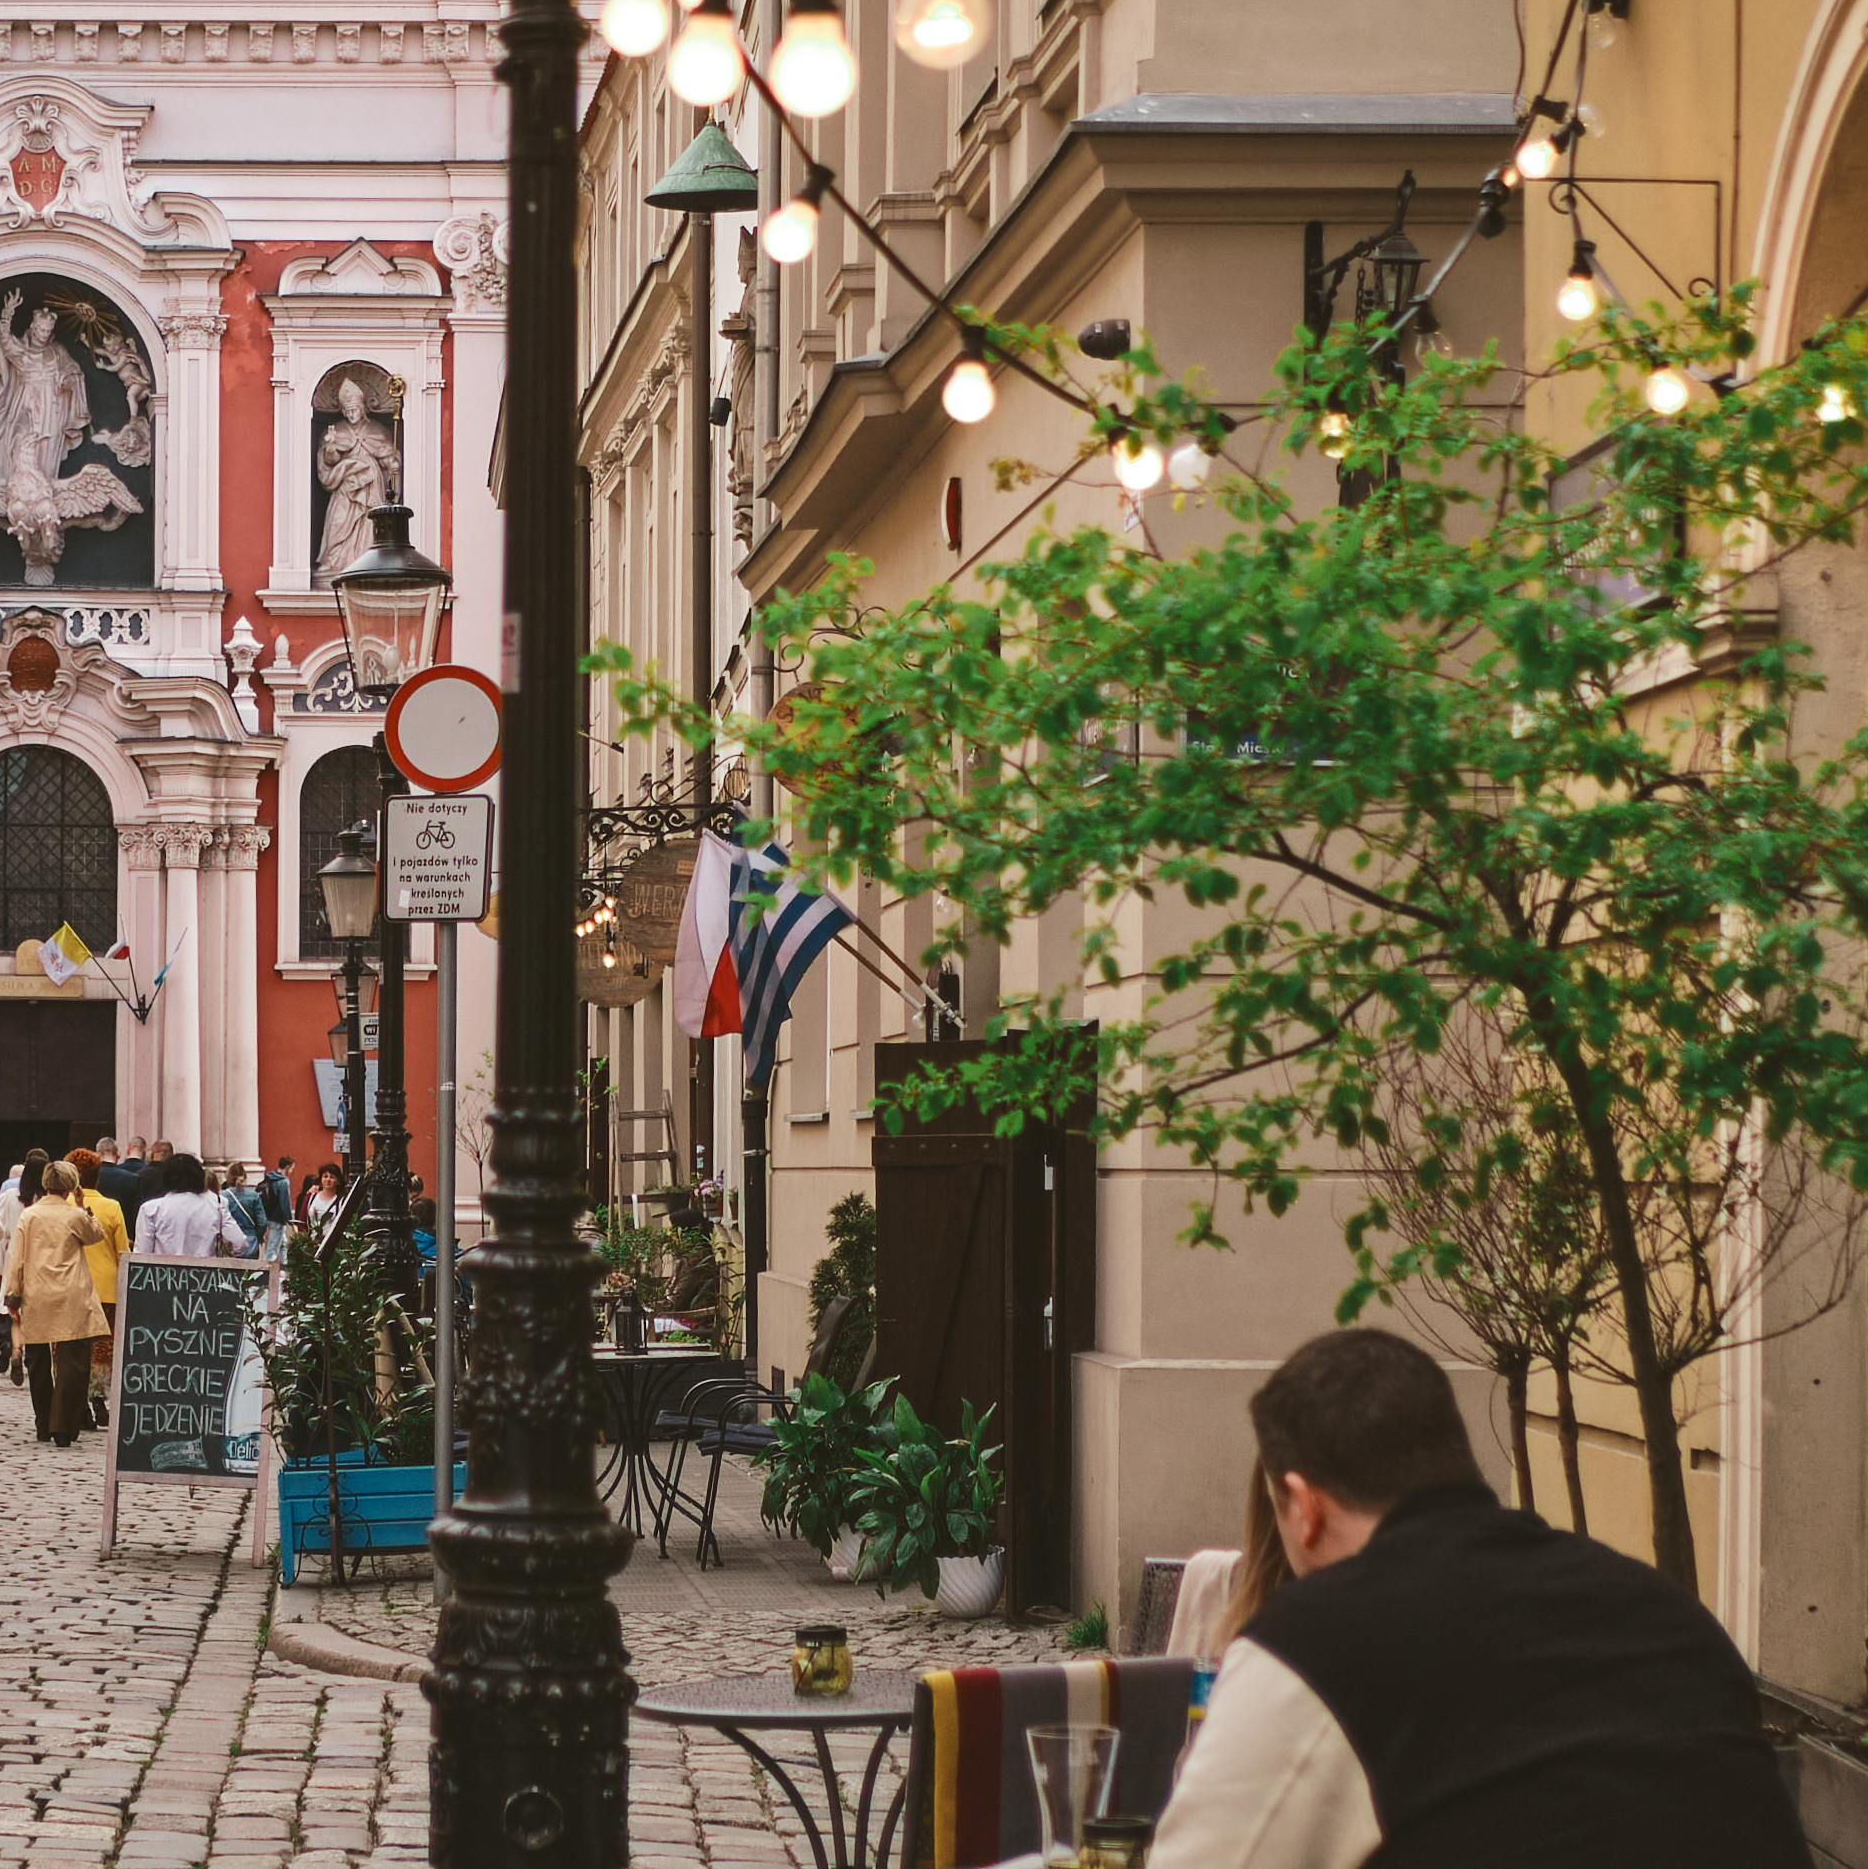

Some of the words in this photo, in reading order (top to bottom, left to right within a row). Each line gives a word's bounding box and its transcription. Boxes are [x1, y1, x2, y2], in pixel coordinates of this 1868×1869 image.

[406, 803, 424, 813] Nie
[428, 803, 467, 816] dotyczy
[400, 855, 449, 870] pojazdów
[453, 855, 478, 870] tylko
[399, 875, 412, 883] na
[415, 872, 471, 883] warunkach
[411, 887, 465, 901] kreślonych
[408, 905, 434, 917] przez
[437, 903, 461, 914] ZDM
[129, 1265, 243, 1298] ZAPRASZAMY
[172, 1293, 210, 1324] NA
[129, 1325, 237, 1358] PYSZNE
[123, 1362, 226, 1398] GRECKIE
